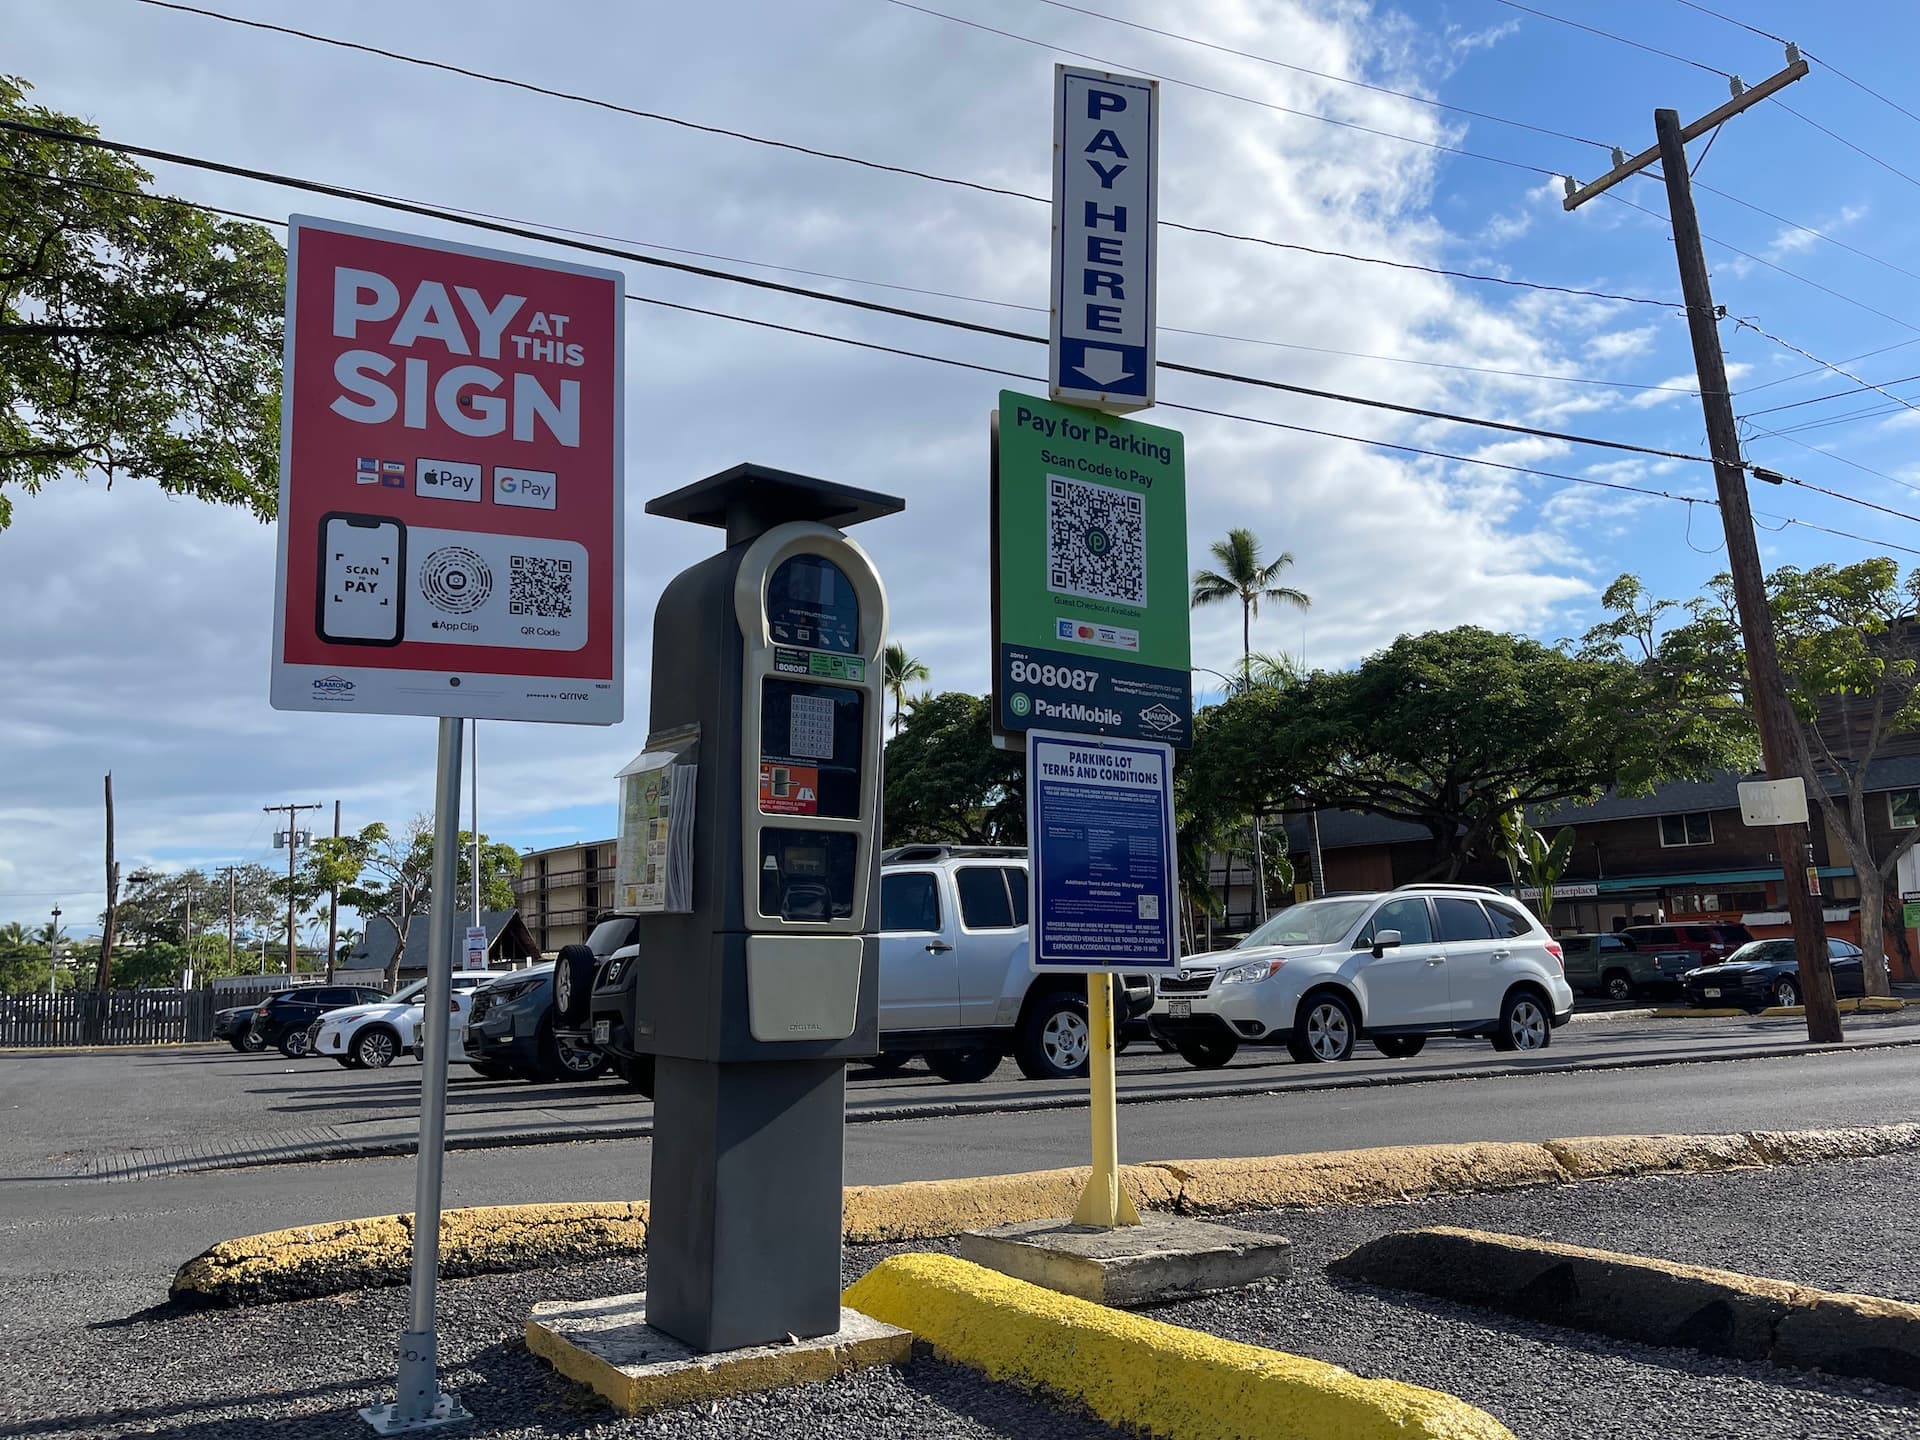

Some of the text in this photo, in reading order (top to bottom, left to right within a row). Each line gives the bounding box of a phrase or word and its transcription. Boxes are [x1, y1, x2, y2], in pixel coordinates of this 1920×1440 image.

[1083, 89, 1128, 334] PAY HERE
[333, 266, 527, 360] PAY
[527, 312, 569, 337] AT
[511, 335, 584, 366] THIS
[329, 350, 581, 448] SIGN
[1017, 406, 1171, 465] Pay for Parking
[1041, 449, 1153, 488] Scan Code to Pay
[440, 471, 474, 491] Pay
[521, 479, 551, 500] Pay
[345, 565, 379, 576] SCAN
[345, 580, 378, 593] PAY
[1054, 596, 1141, 618] Guest Checkout Available
[440, 621, 479, 632] App Clip
[521, 626, 560, 637] QR Code
[779, 663, 808, 674] 808087
[1010, 661, 1099, 692] 808087
[314, 680, 353, 690] DIAMOND
[560, 692, 589, 700] arrive
[1035, 699, 1122, 725] ParkMobile
[1069, 752, 1132, 768] PARKING LOT
[1043, 763, 1158, 784] TERMS AND CONDITIONS
[1551, 887, 1595, 898] arketplace
